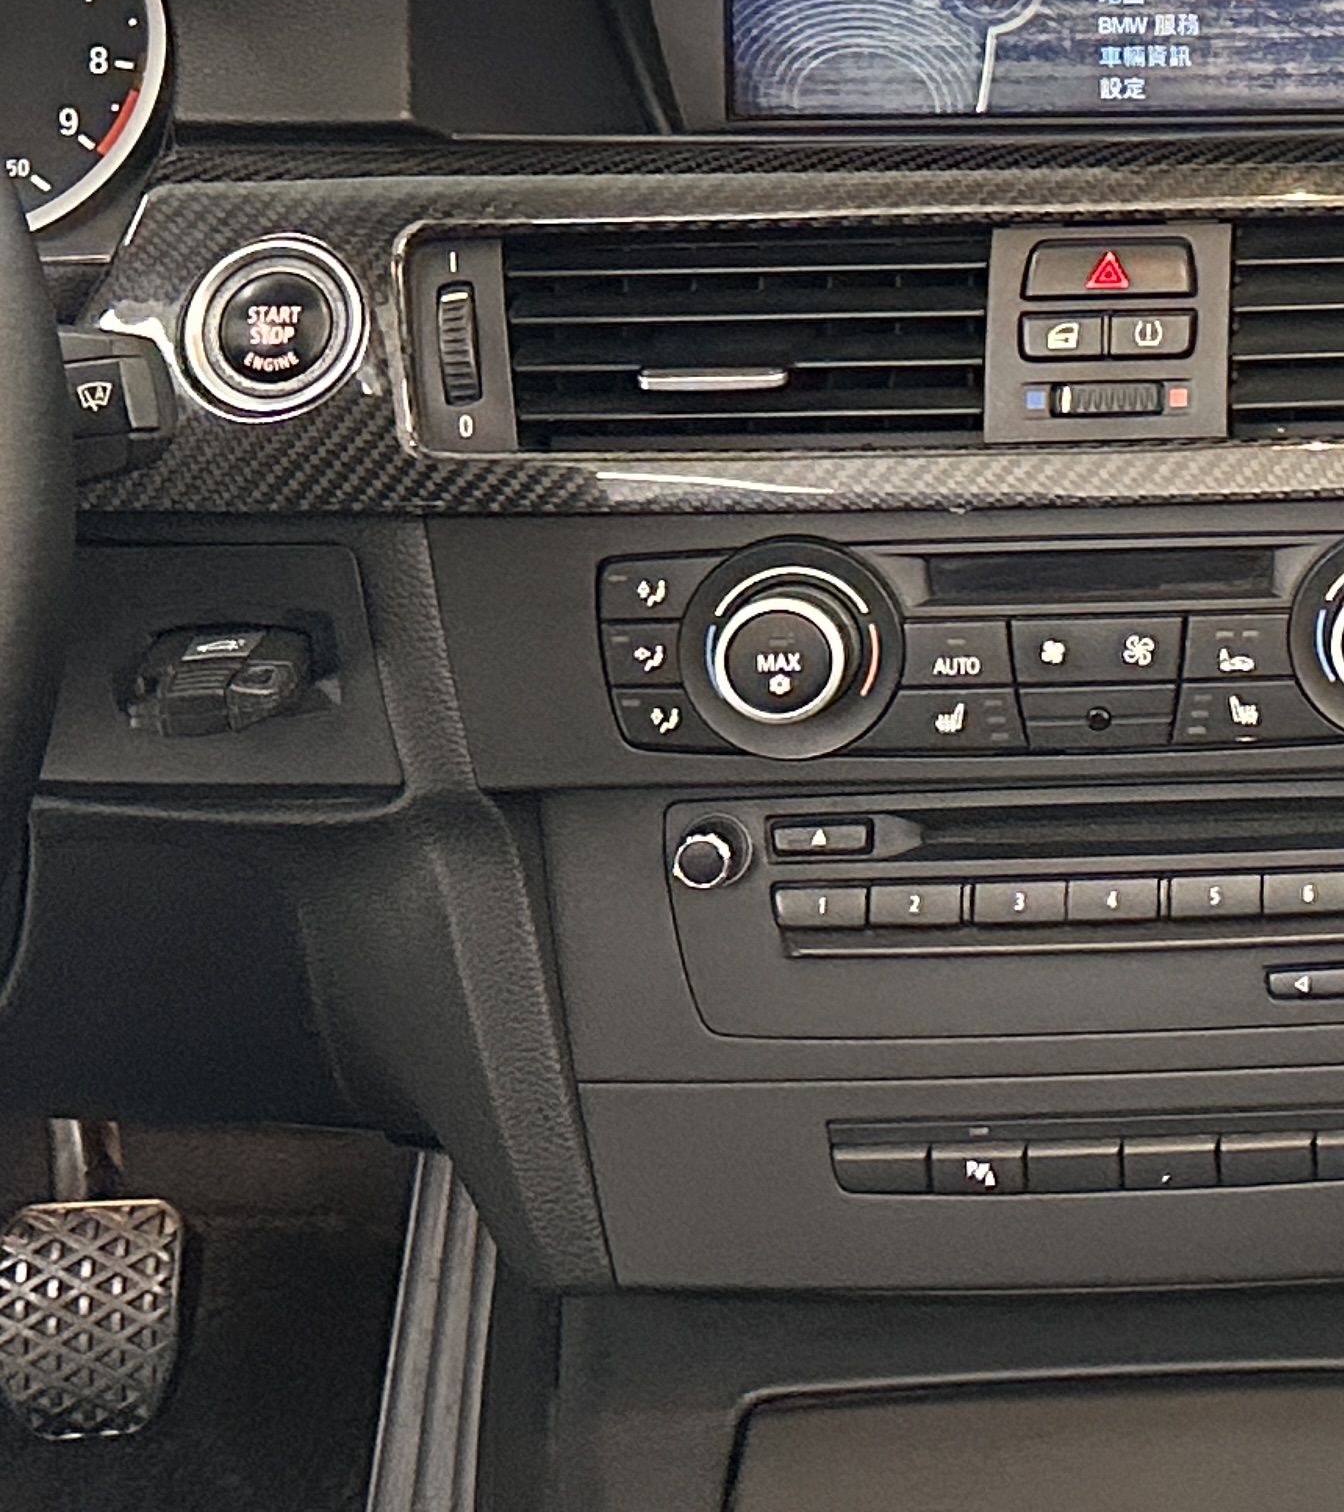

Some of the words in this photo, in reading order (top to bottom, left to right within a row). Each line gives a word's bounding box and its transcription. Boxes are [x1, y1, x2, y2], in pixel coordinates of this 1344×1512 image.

[1097, 16, 1149, 35] BMW
[1153, 13, 1201, 36] 服務
[89, 45, 109, 75] 8
[1099, 44, 1192, 68] 車輛資訊
[1100, 76, 1146, 100] 設定
[58, 107, 79, 136] 9
[5, 158, 31, 178] 50
[247, 305, 302, 325] START
[249, 325, 295, 345] STOP
[243, 351, 300, 372] ENGINE
[756, 652, 801, 673] MAX
[932, 657, 982, 676] AUTO
[818, 896, 828, 915] 1
[907, 894, 921, 913] 2
[1012, 892, 1026, 912] 3
[1105, 890, 1119, 909] 4
[1208, 886, 1222, 906] 5
[1301, 883, 1316, 904] 6
